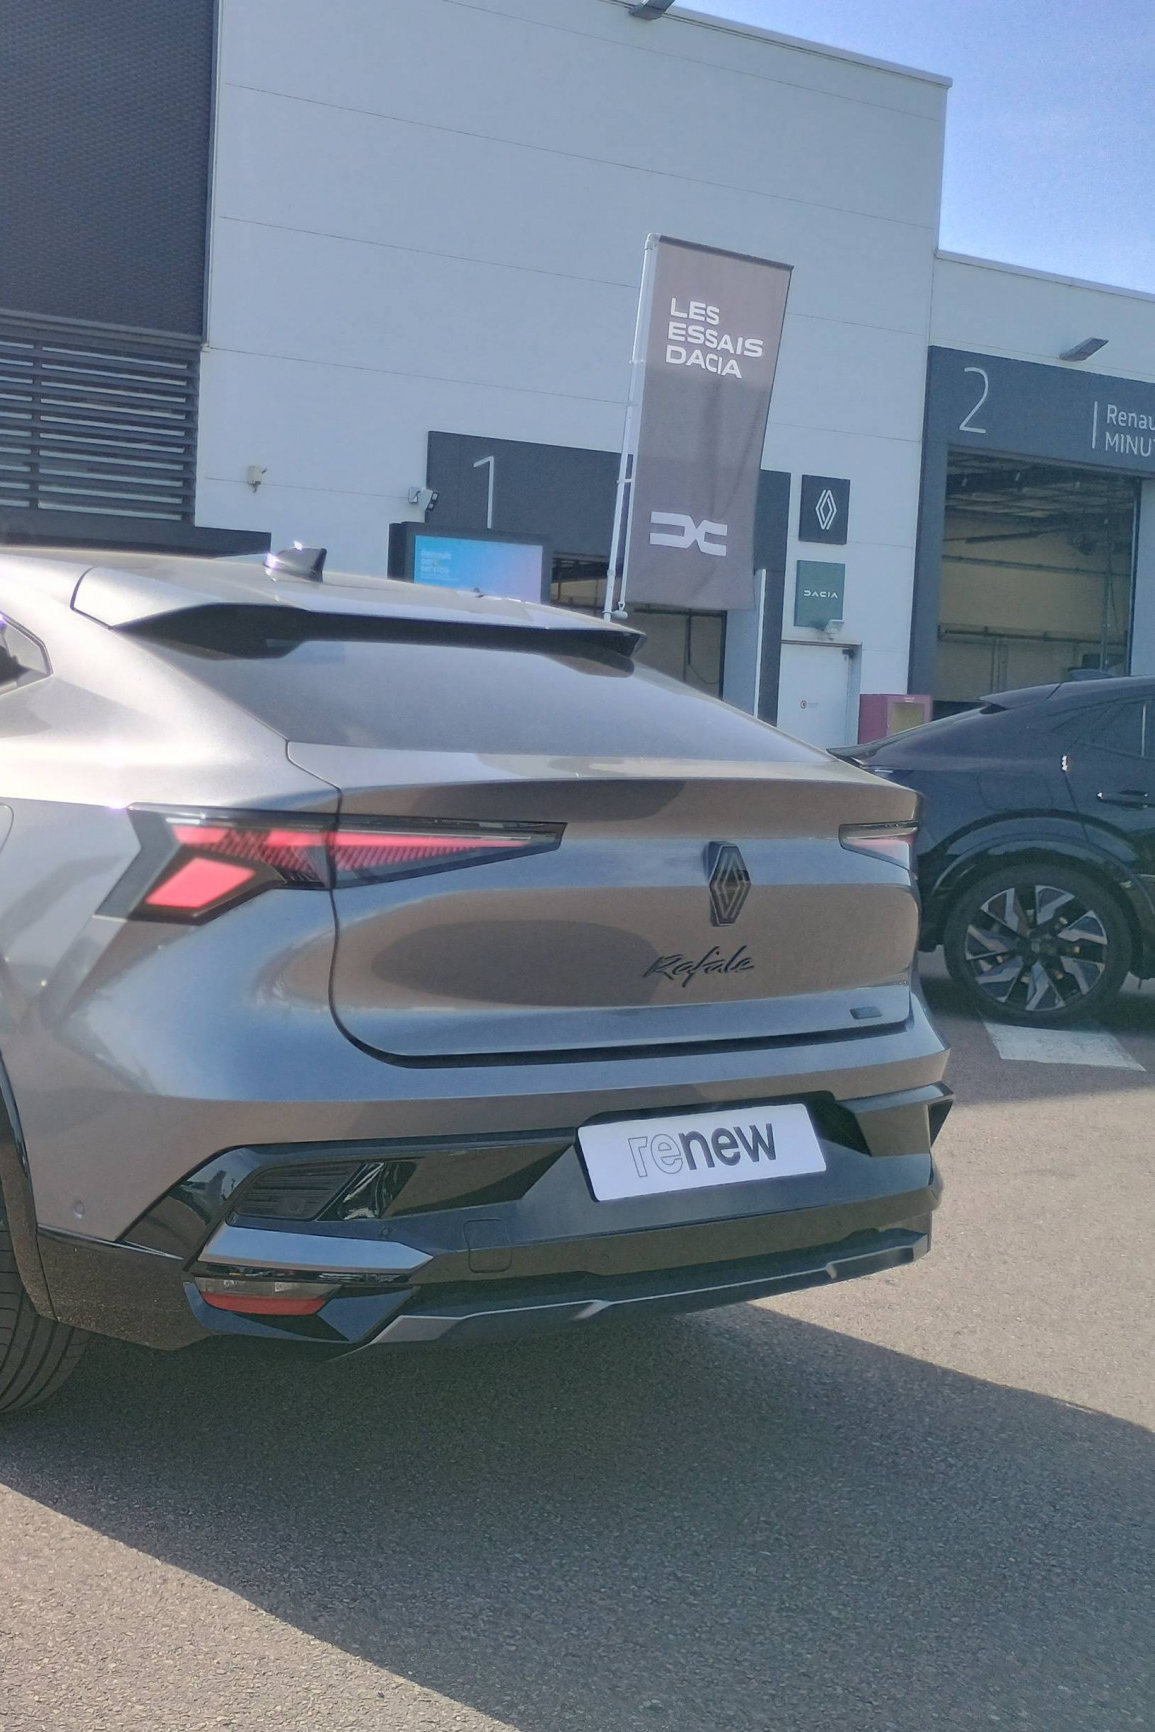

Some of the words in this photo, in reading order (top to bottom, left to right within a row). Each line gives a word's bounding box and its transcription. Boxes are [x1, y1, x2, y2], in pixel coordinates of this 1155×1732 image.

[670, 298, 720, 326] LES
[667, 321, 764, 358] ESSAIS
[665, 344, 743, 379] DACIA
[959, 366, 989, 434] 2
[1105, 431, 1155, 458] MINU
[473, 455, 495, 529] 1
[803, 590, 838, 599] DACIA
[627, 1122, 777, 1179] renew
